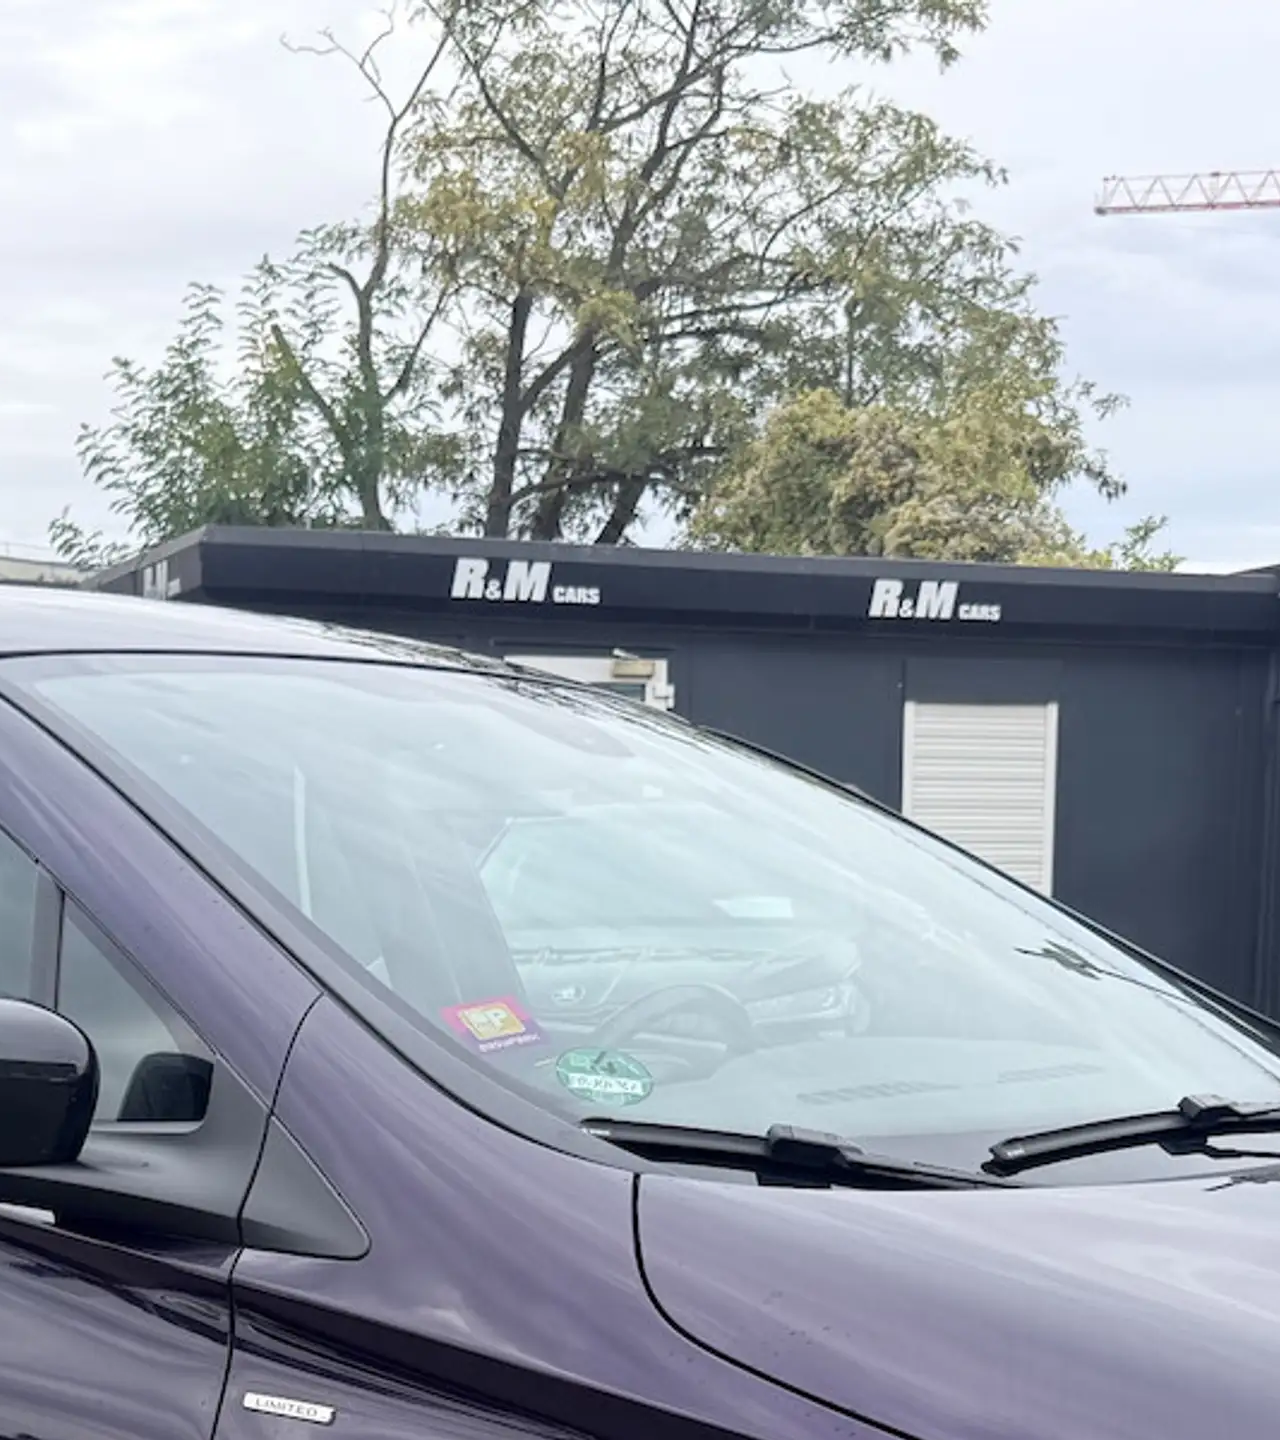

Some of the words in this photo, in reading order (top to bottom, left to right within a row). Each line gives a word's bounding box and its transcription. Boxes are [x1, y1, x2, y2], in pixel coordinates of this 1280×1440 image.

[451, 556, 552, 602] R&M
[553, 586, 601, 605] CARS
[869, 578, 959, 620] R&M
[959, 603, 1002, 621] CARS
[255, 1397, 318, 1417] LIMITED
